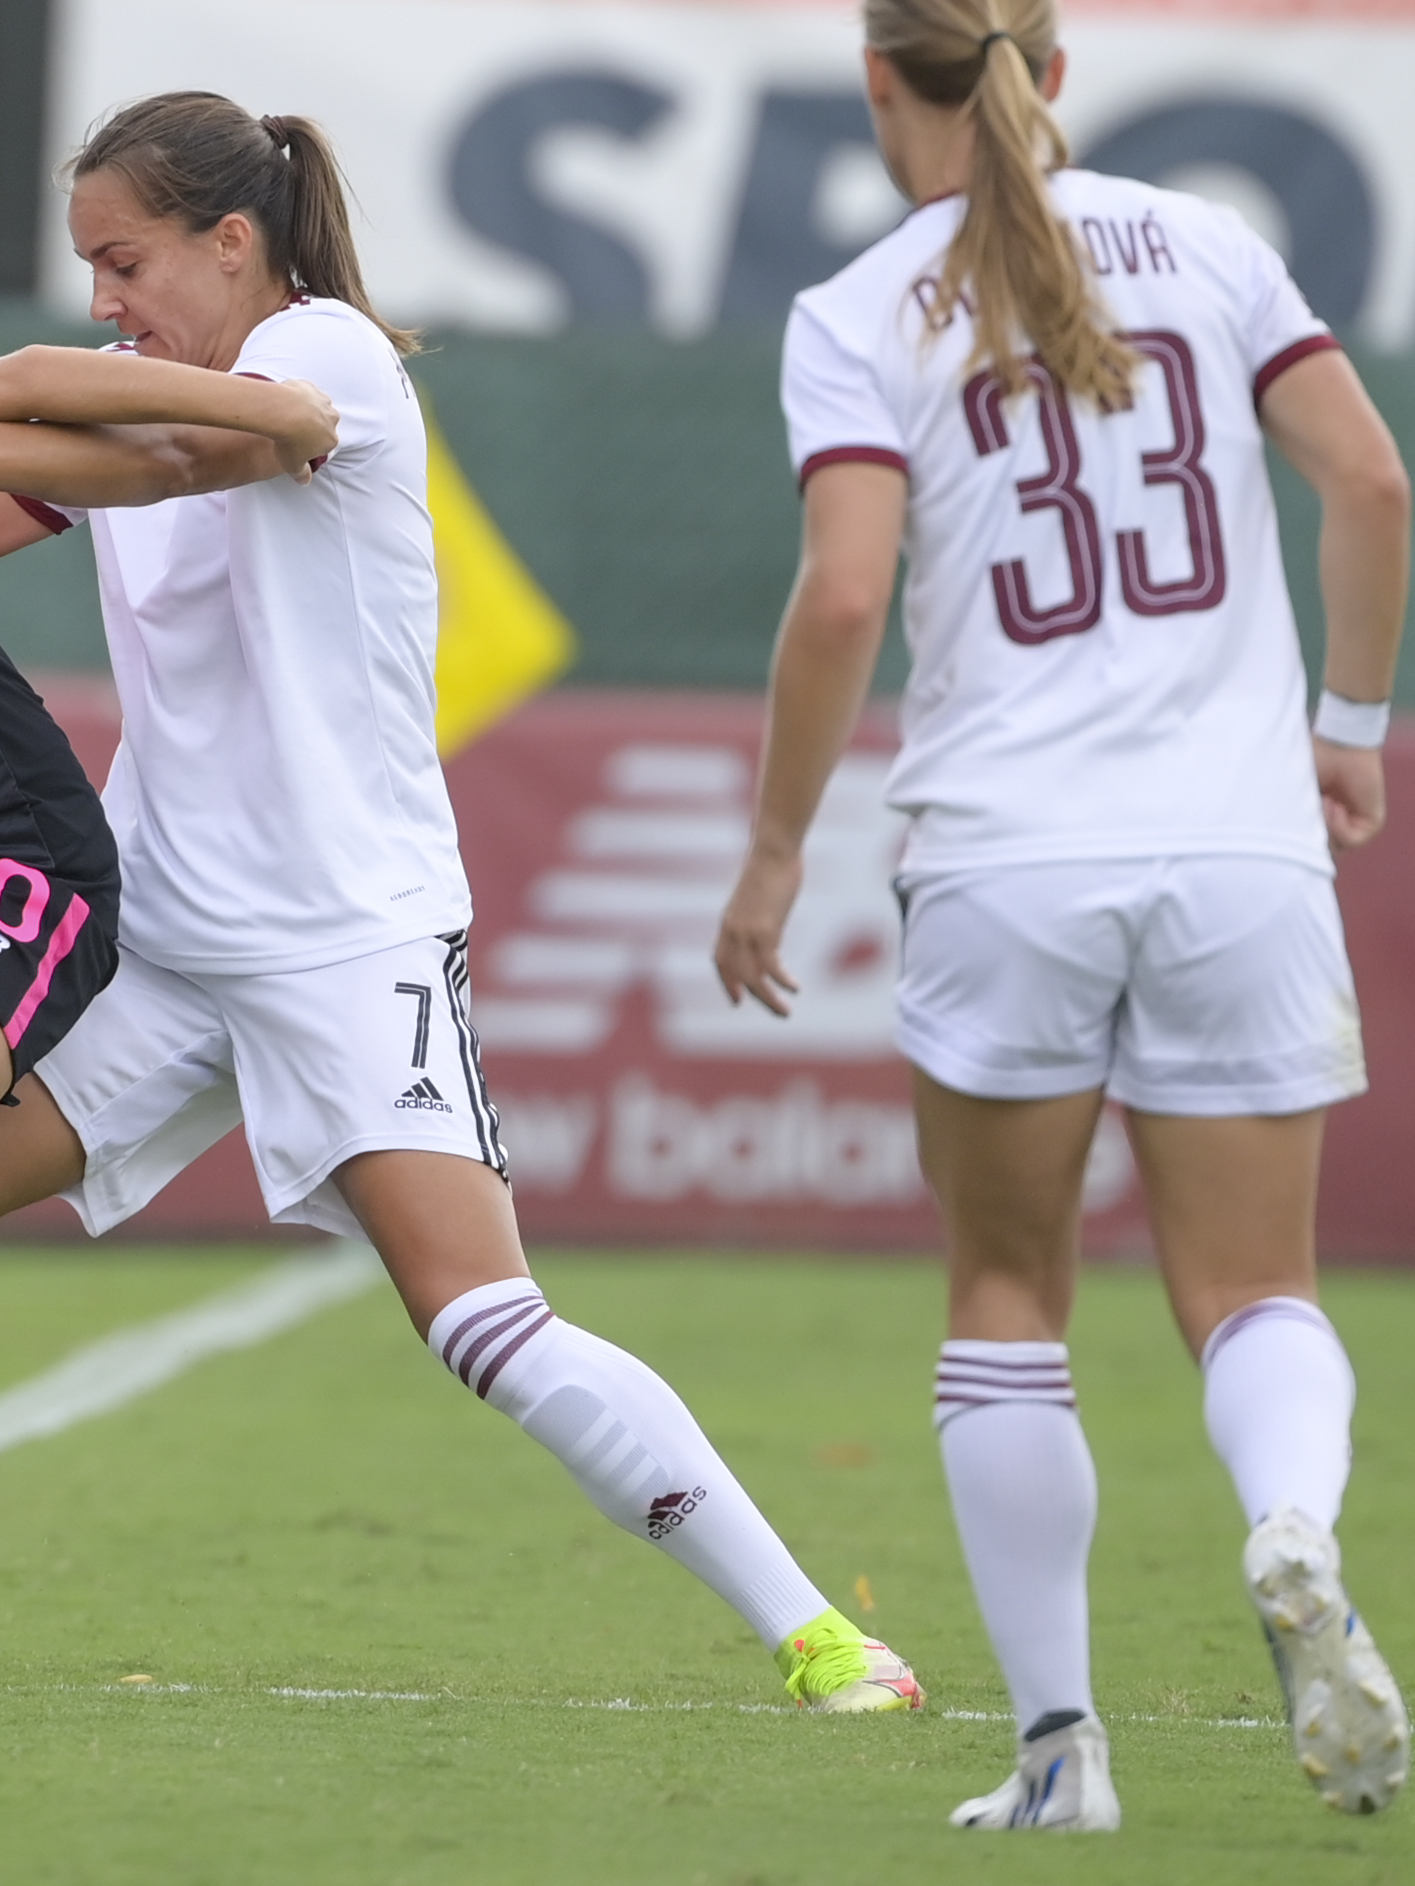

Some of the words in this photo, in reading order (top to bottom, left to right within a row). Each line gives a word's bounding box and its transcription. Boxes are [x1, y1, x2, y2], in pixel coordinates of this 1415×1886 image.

[963, 330, 1226, 645] 33
[394, 981, 432, 1069] 7
[394, 1097, 453, 1114] adidas
[648, 1485, 707, 1540] adidas
